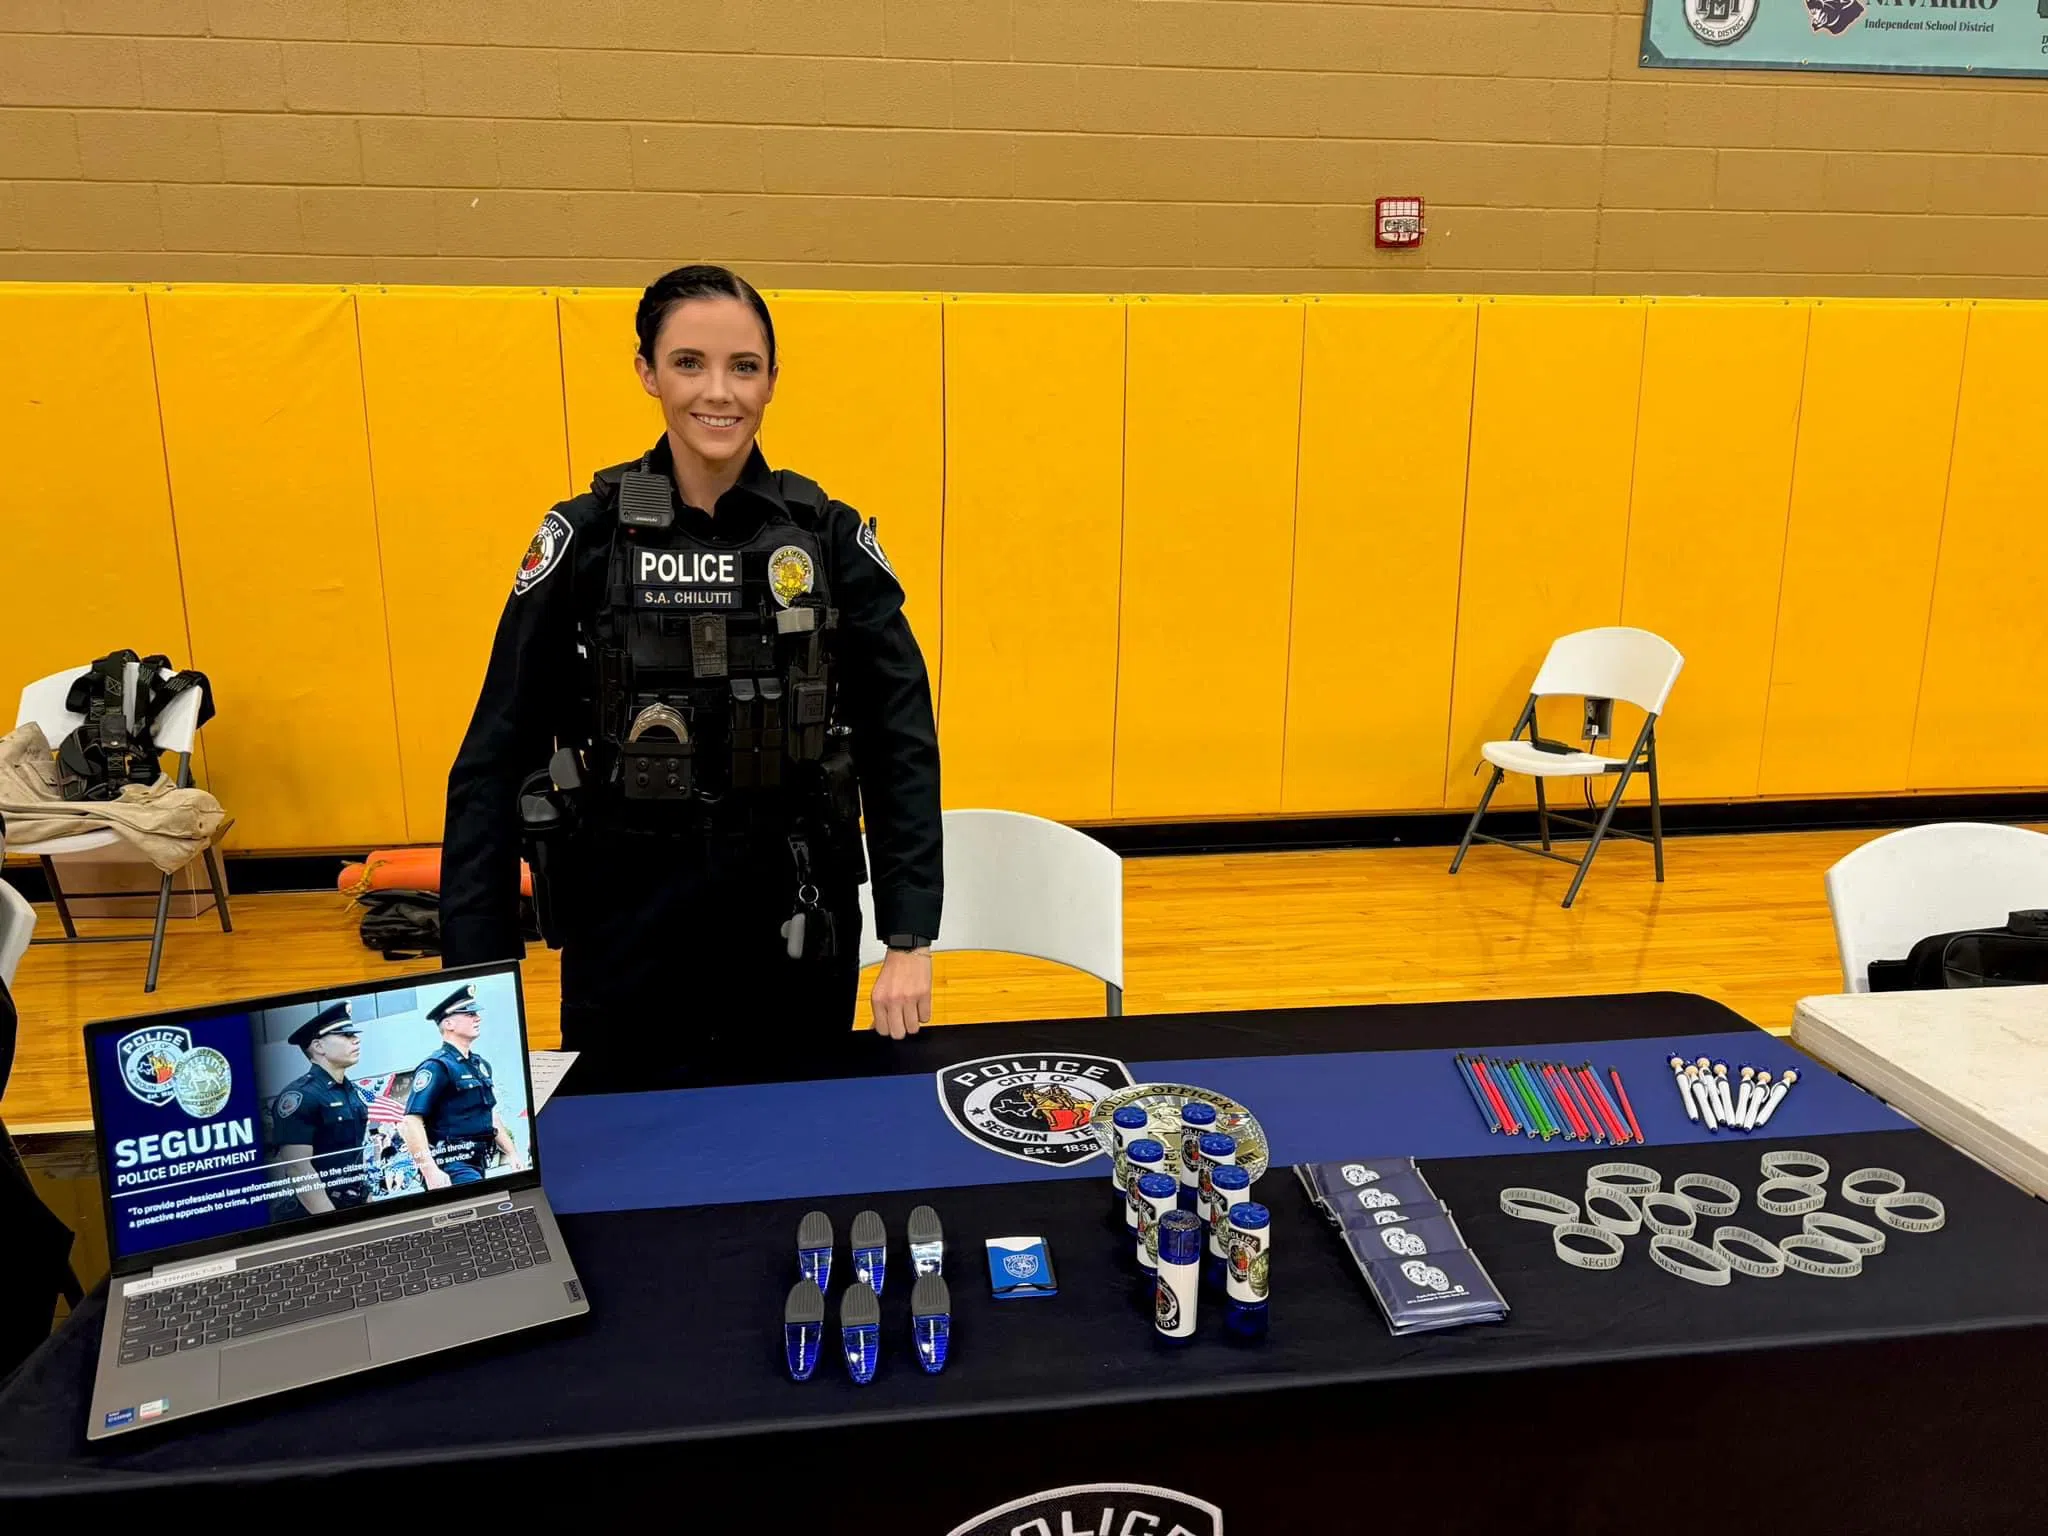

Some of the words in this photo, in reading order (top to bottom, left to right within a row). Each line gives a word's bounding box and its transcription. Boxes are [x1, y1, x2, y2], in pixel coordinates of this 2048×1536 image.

[1693, 20, 1716, 38] SCHOOL
[1717, 16, 1746, 37] DISTRICT
[1865, 19, 1923, 32] Independent
[1925, 21, 1957, 31] School
[1959, 22, 1995, 33] District
[641, 552, 734, 583] POLICE
[645, 592, 670, 604] S.A.
[675, 592, 732, 604] CHILUTTI
[122, 1031, 185, 1054] POLICE
[953, 1060, 1110, 1087] POLICE
[998, 1074, 1037, 1087] CITY
[1050, 1074, 1079, 1083] OF
[1152, 1086, 1234, 1111] OFFICER
[116, 1117, 254, 1168] SEGUIN
[980, 1119, 1048, 1143] SEGUIN
[1023, 1146, 1057, 1156] Est.
[1062, 1143, 1099, 1153] 1838
[117, 1166, 167, 1187] POLICE
[169, 1150, 257, 1177] DEPARTMENT
[137, 1213, 175, 1228] proactive
[176, 1204, 214, 1219] approach
[215, 1202, 223, 1210] to
[224, 1197, 250, 1209] crime,
[251, 1188, 295, 1205] partnership
[296, 1184, 313, 1194] with
[314, 1181, 326, 1190] the
[327, 1173, 368, 1188] community
[144, 1201, 175, 1215] provide
[176, 1190, 225, 1208] professional
[226, 1188, 241, 1197] law
[242, 1179, 291, 1194] enforcement
[292, 1172, 319, 1184] service
[320, 1170, 329, 1178] to
[330, 1167, 342, 1176] the
[1888, 1215, 1929, 1231] SEGUIN
[1582, 1256, 1619, 1268] SEGUIN
[1740, 1262, 1780, 1275] SEGUIN
